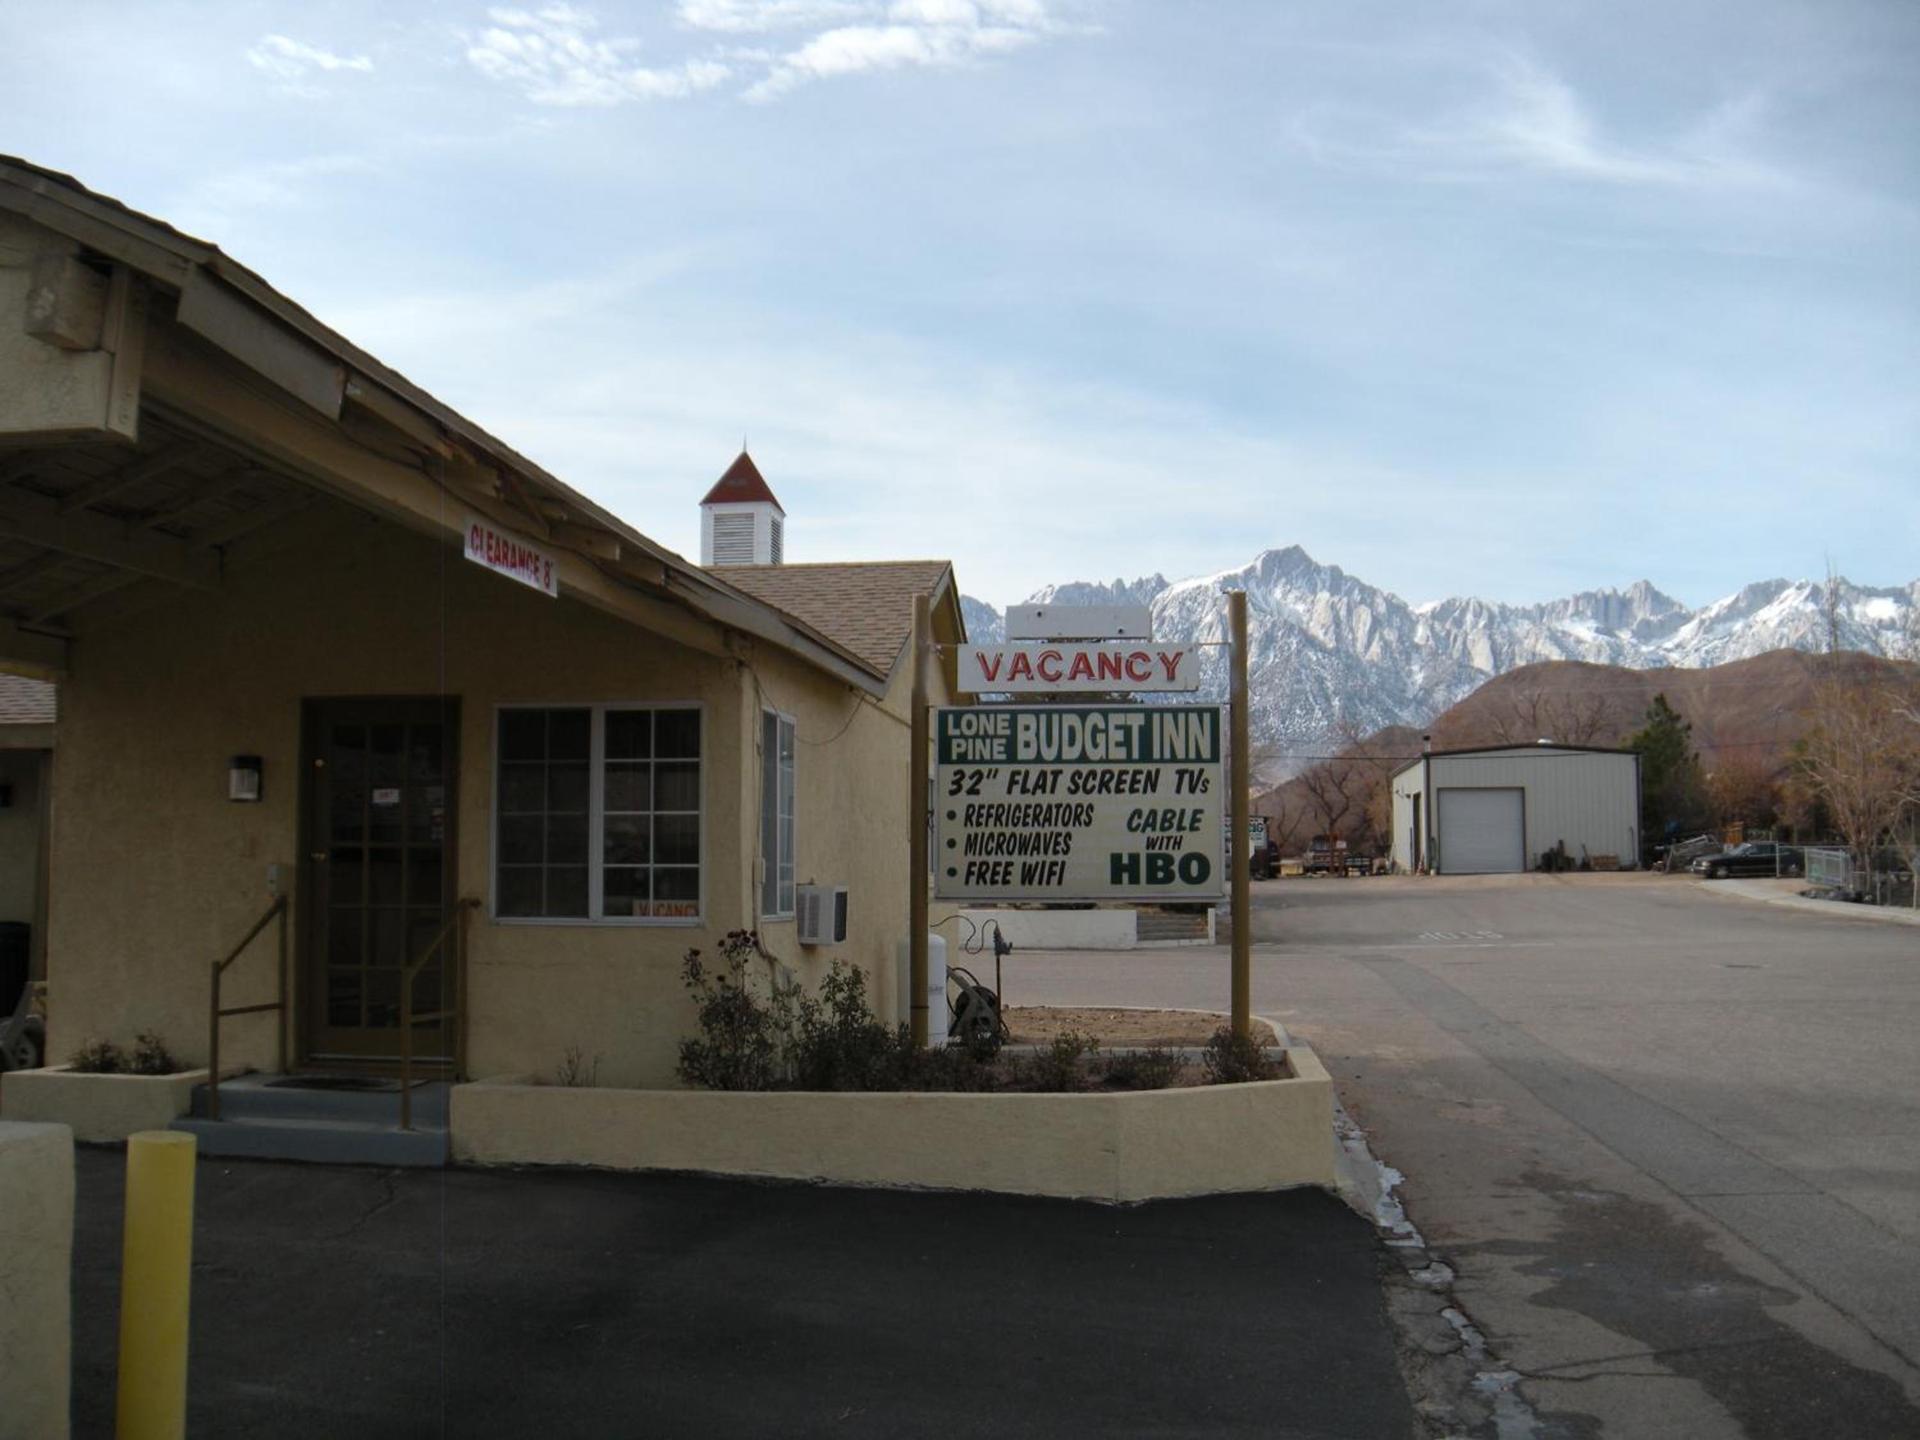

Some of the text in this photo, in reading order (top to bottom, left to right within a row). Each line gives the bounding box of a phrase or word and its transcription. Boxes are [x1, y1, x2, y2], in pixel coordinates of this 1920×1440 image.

[470, 523, 540, 583] CLEARANCE
[976, 651, 1183, 682] VACANCY
[948, 713, 1010, 735] LONE
[1017, 712, 1211, 760] BUDGET INN
[952, 738, 1007, 760] PINE
[1006, 769, 1062, 795] FLAT
[1067, 768, 1160, 795] SCREEN
[963, 803, 1094, 827] REFRIGERATORS
[1126, 808, 1204, 833] CABLE
[964, 832, 1072, 856] MICROWAVES
[1145, 836, 1183, 851] WITH
[964, 860, 1067, 886] FREE WIFI
[1110, 853, 1211, 885] HBO
